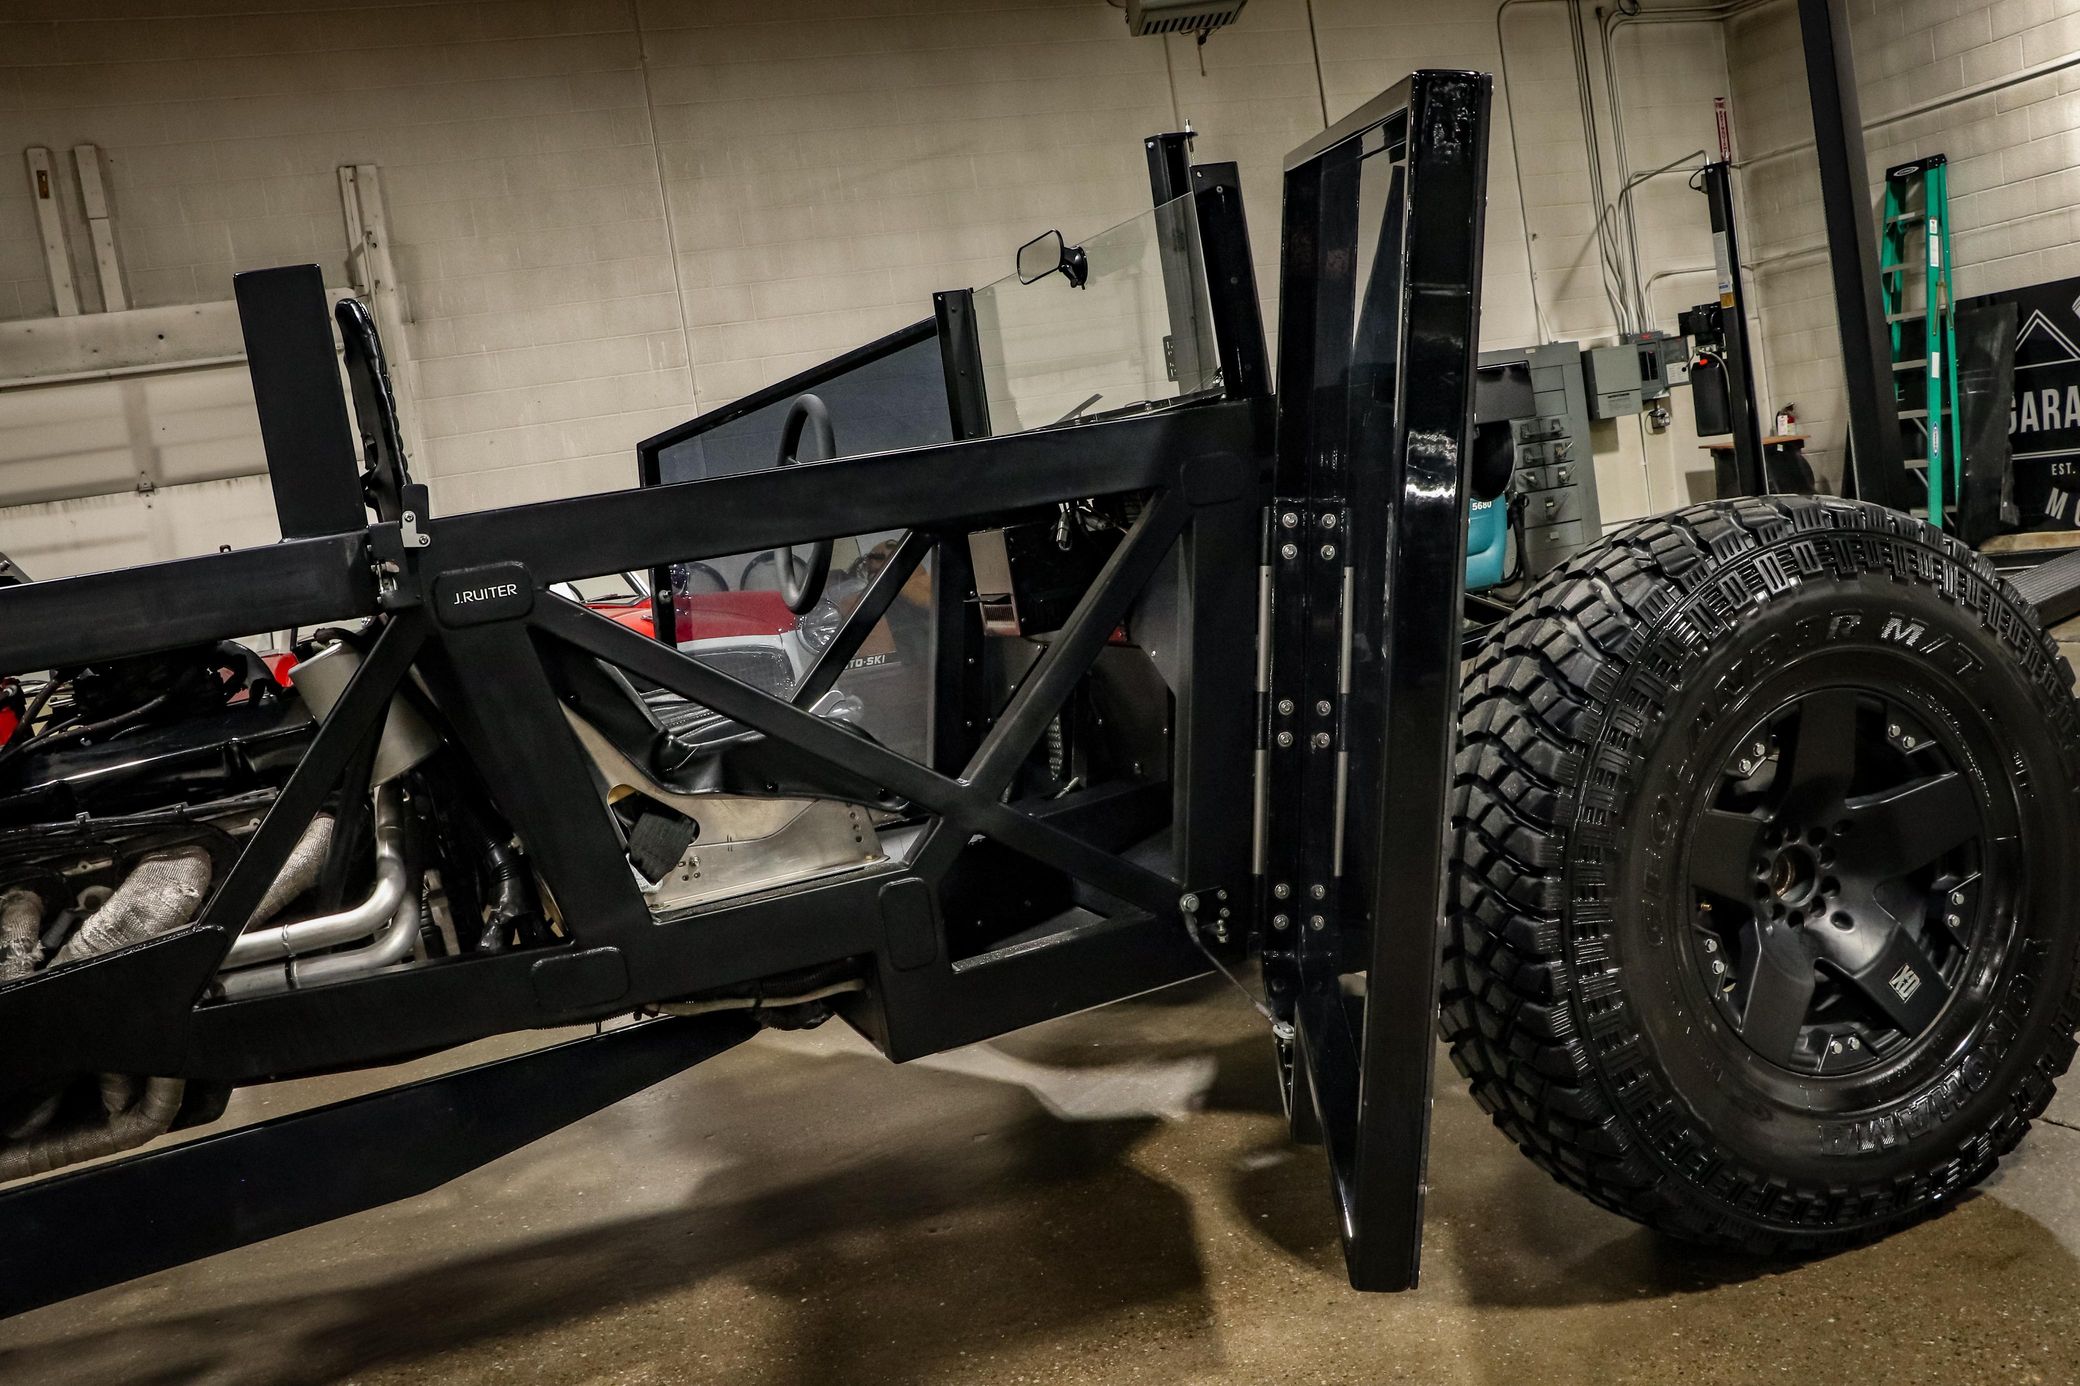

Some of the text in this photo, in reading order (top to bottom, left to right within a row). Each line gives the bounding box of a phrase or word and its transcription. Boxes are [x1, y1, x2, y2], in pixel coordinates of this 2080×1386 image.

[2051, 462, 2077, 476] EST.
[1472, 501, 1492, 511] 5680
[453, 583, 518, 605] J.RUITER
[1880, 612, 1985, 678] M/T
[846, 654, 886, 669] TO-SKI
